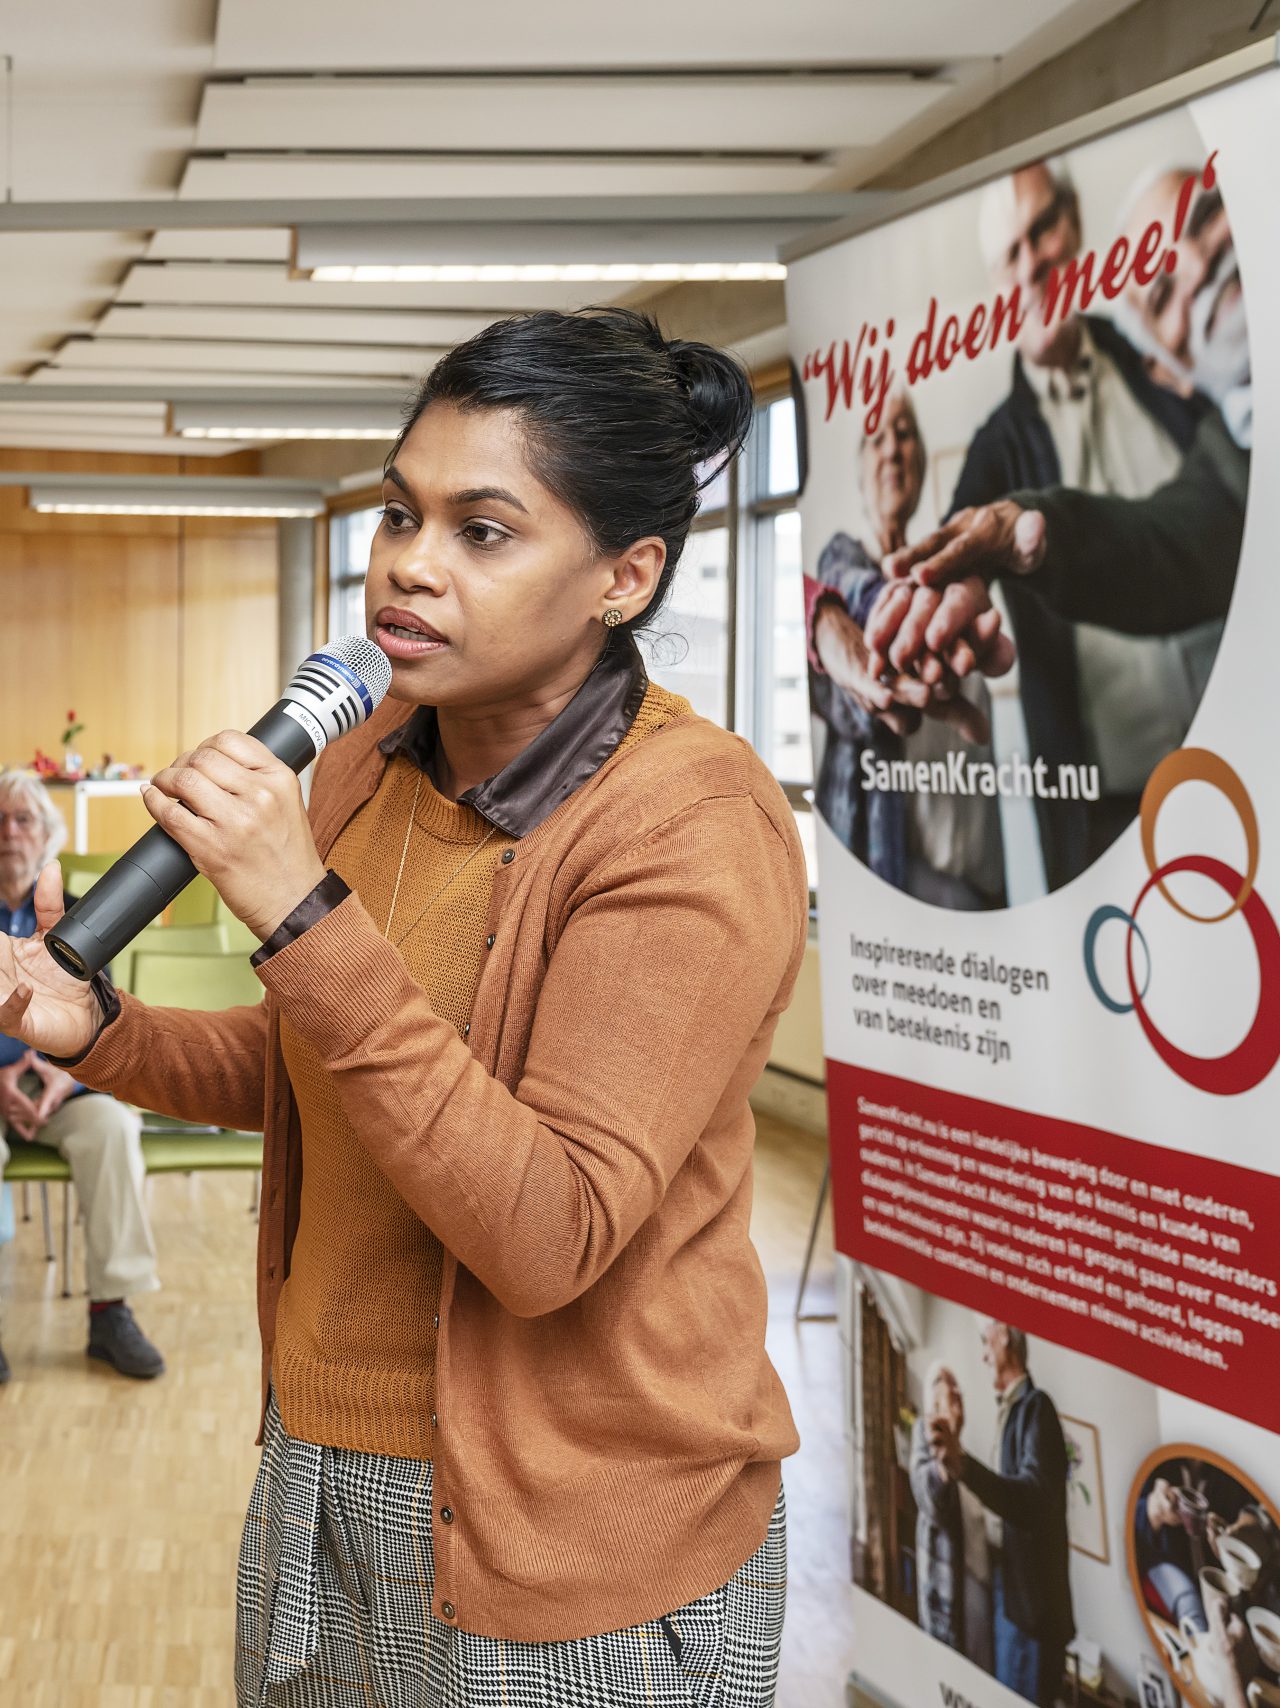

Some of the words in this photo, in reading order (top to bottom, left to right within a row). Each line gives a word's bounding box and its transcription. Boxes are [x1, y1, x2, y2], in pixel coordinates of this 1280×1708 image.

[906, 285, 1027, 387] doen
[299, 713, 311, 727] MIC
[860, 749, 1100, 801] SamenKracht.nu
[850, 934, 955, 976] Inspirerende
[961, 952, 1049, 995] dialogen
[852, 971, 887, 997] over
[892, 976, 972, 1016] meedoen
[978, 998, 1001, 1021] en
[854, 1005, 883, 1031] van
[887, 1007, 970, 1052] betekenis
[977, 1029, 1011, 1065] zijn
[949, 1128, 972, 1145] een
[970, 1131, 1031, 1164] landelijke
[1031, 1148, 1099, 1186] beweging
[1098, 1167, 1129, 1190] door
[1129, 1179, 1149, 1198] en
[1149, 1185, 1181, 1208] met
[1182, 1194, 1255, 1231] ouderen,
[960, 1156, 979, 1172] en
[977, 1162, 1047, 1199] waardering
[1046, 1183, 1074, 1202] van
[1074, 1187, 1094, 1208] de
[1094, 1192, 1139, 1223] kennis
[1138, 1211, 1158, 1229] en
[1159, 1213, 1209, 1245] kunde
[1210, 1232, 1241, 1254] van
[1036, 1203, 1114, 1241] begeleiden
[1182, 1253, 1278, 1297] moderators
[1067, 1240, 1083, 1259] in
[1138, 1267, 1175, 1293] gaan
[1175, 1280, 1213, 1305] over
[1214, 1292, 1280, 1329] meedoe
[1053, 1265, 1105, 1294] erkend
[1104, 1282, 1124, 1300] en
[1187, 1309, 1244, 1346] leggen
[1090, 1304, 1139, 1335] nieuwe
